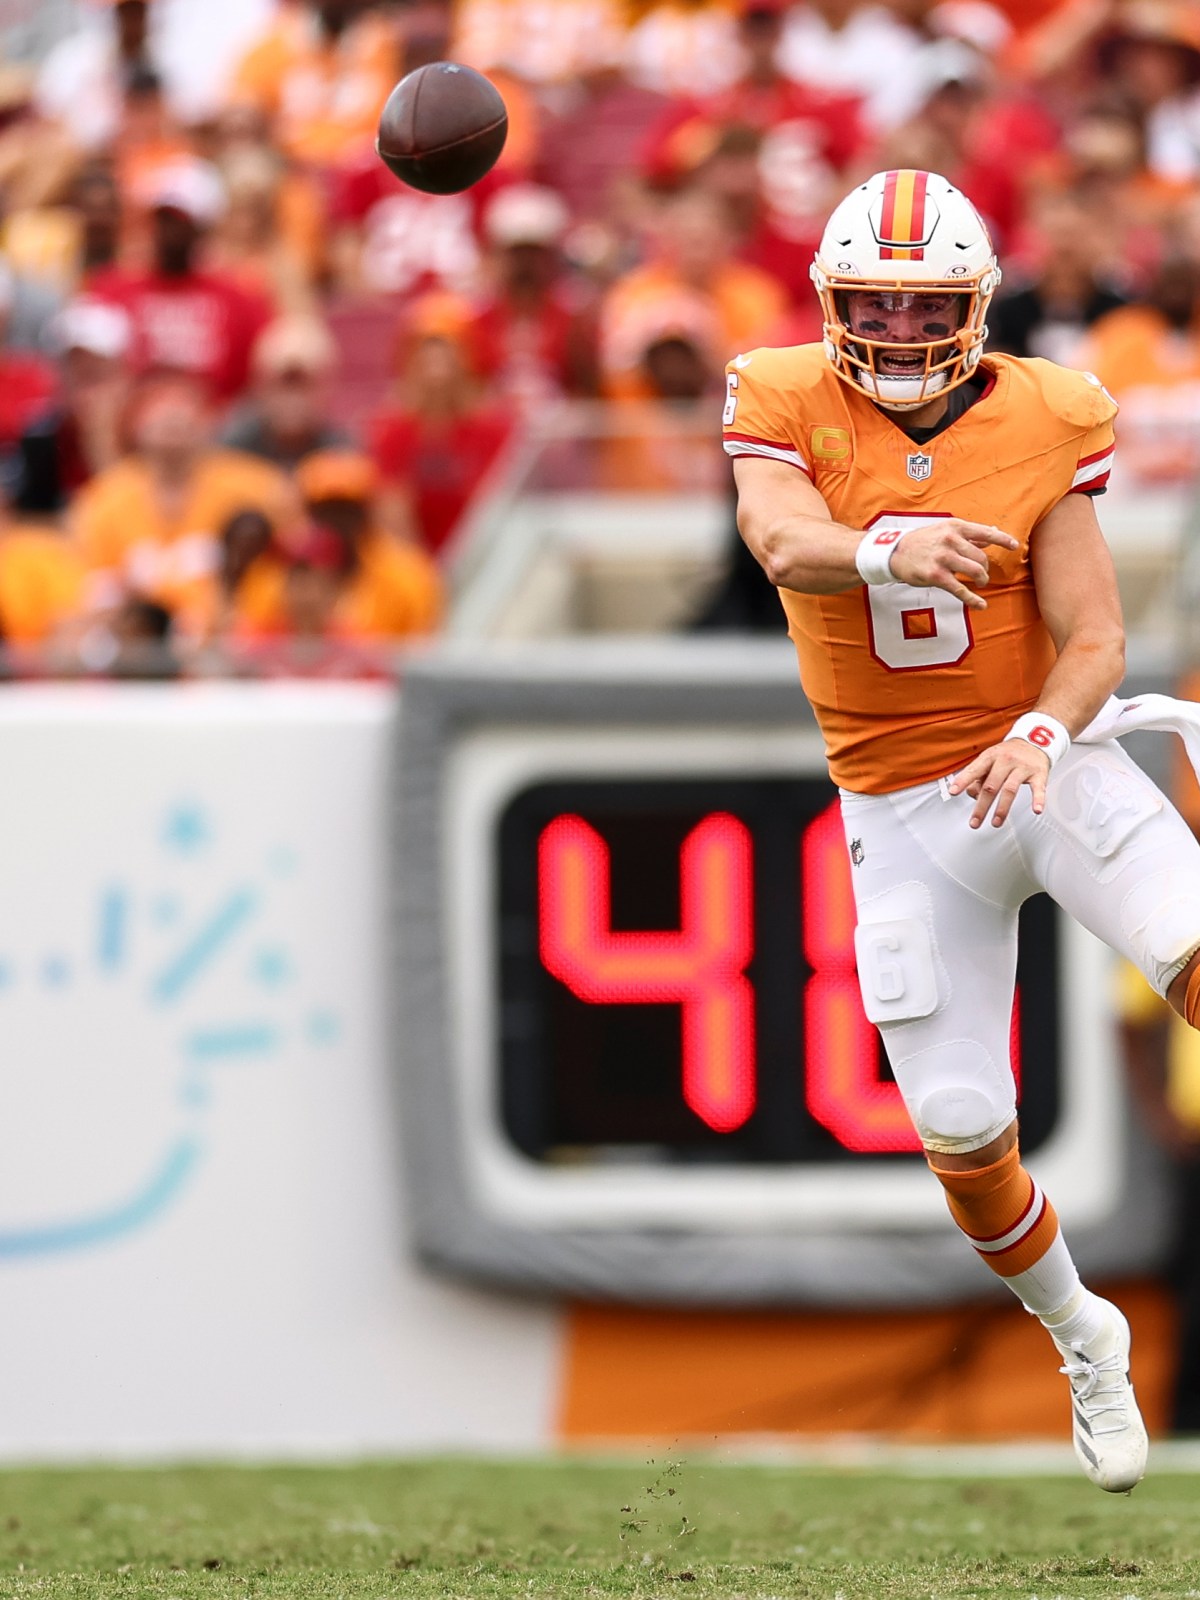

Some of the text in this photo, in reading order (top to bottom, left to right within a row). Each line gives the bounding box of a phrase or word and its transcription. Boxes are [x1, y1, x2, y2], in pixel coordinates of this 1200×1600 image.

[722, 371, 738, 426] 6
[811, 427, 850, 459] C
[911, 465, 927, 476] NFL
[862, 510, 975, 673] 6
[1027, 725, 1056, 747] 6
[870, 936, 905, 1002] 6
